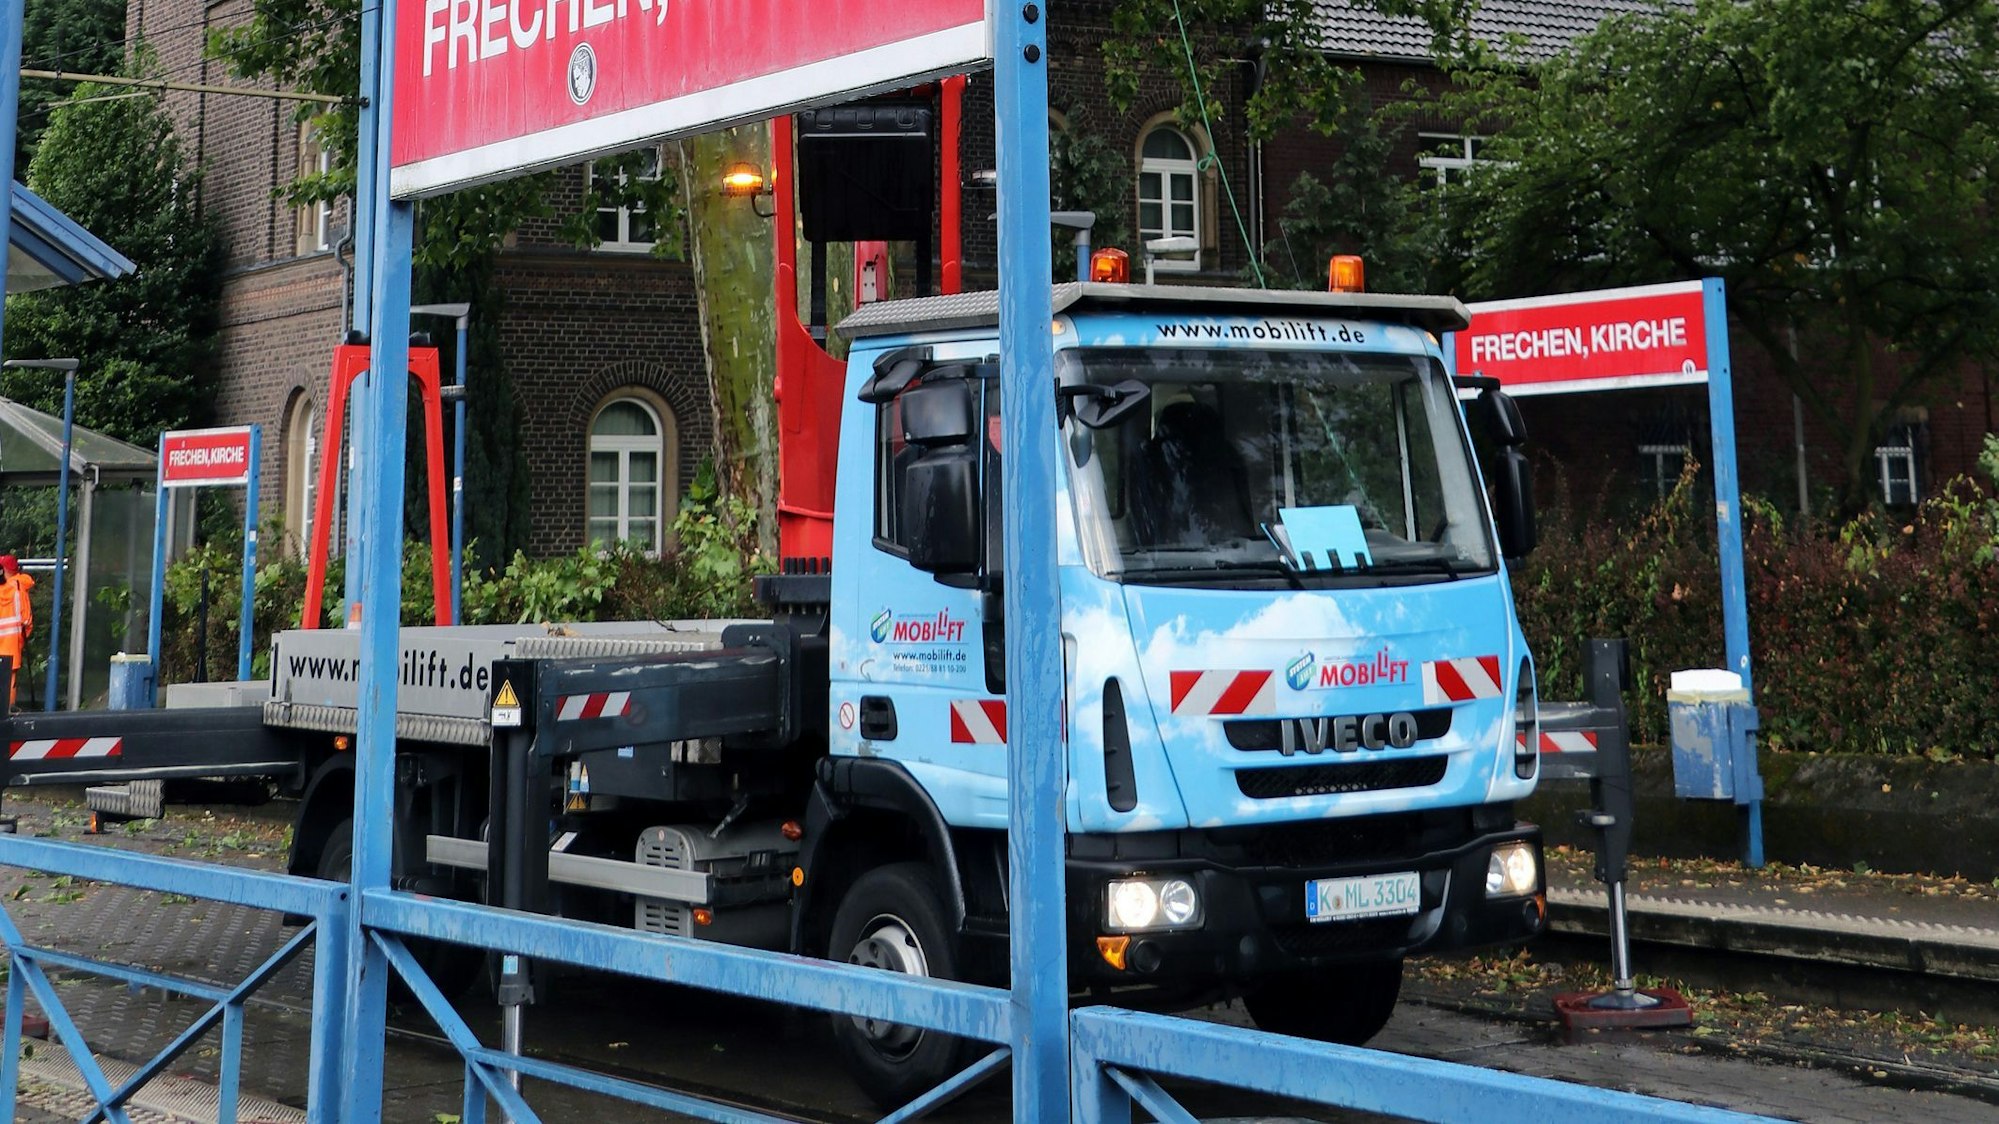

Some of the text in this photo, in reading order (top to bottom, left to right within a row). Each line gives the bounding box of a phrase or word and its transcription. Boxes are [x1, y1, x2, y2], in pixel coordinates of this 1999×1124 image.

[1157, 321, 1365, 343] www.mobilift.de
[893, 648, 966, 662] www.mobilift.de
[1281, 712, 1418, 756] IVECO
[1374, 878, 1417, 906] 3304
